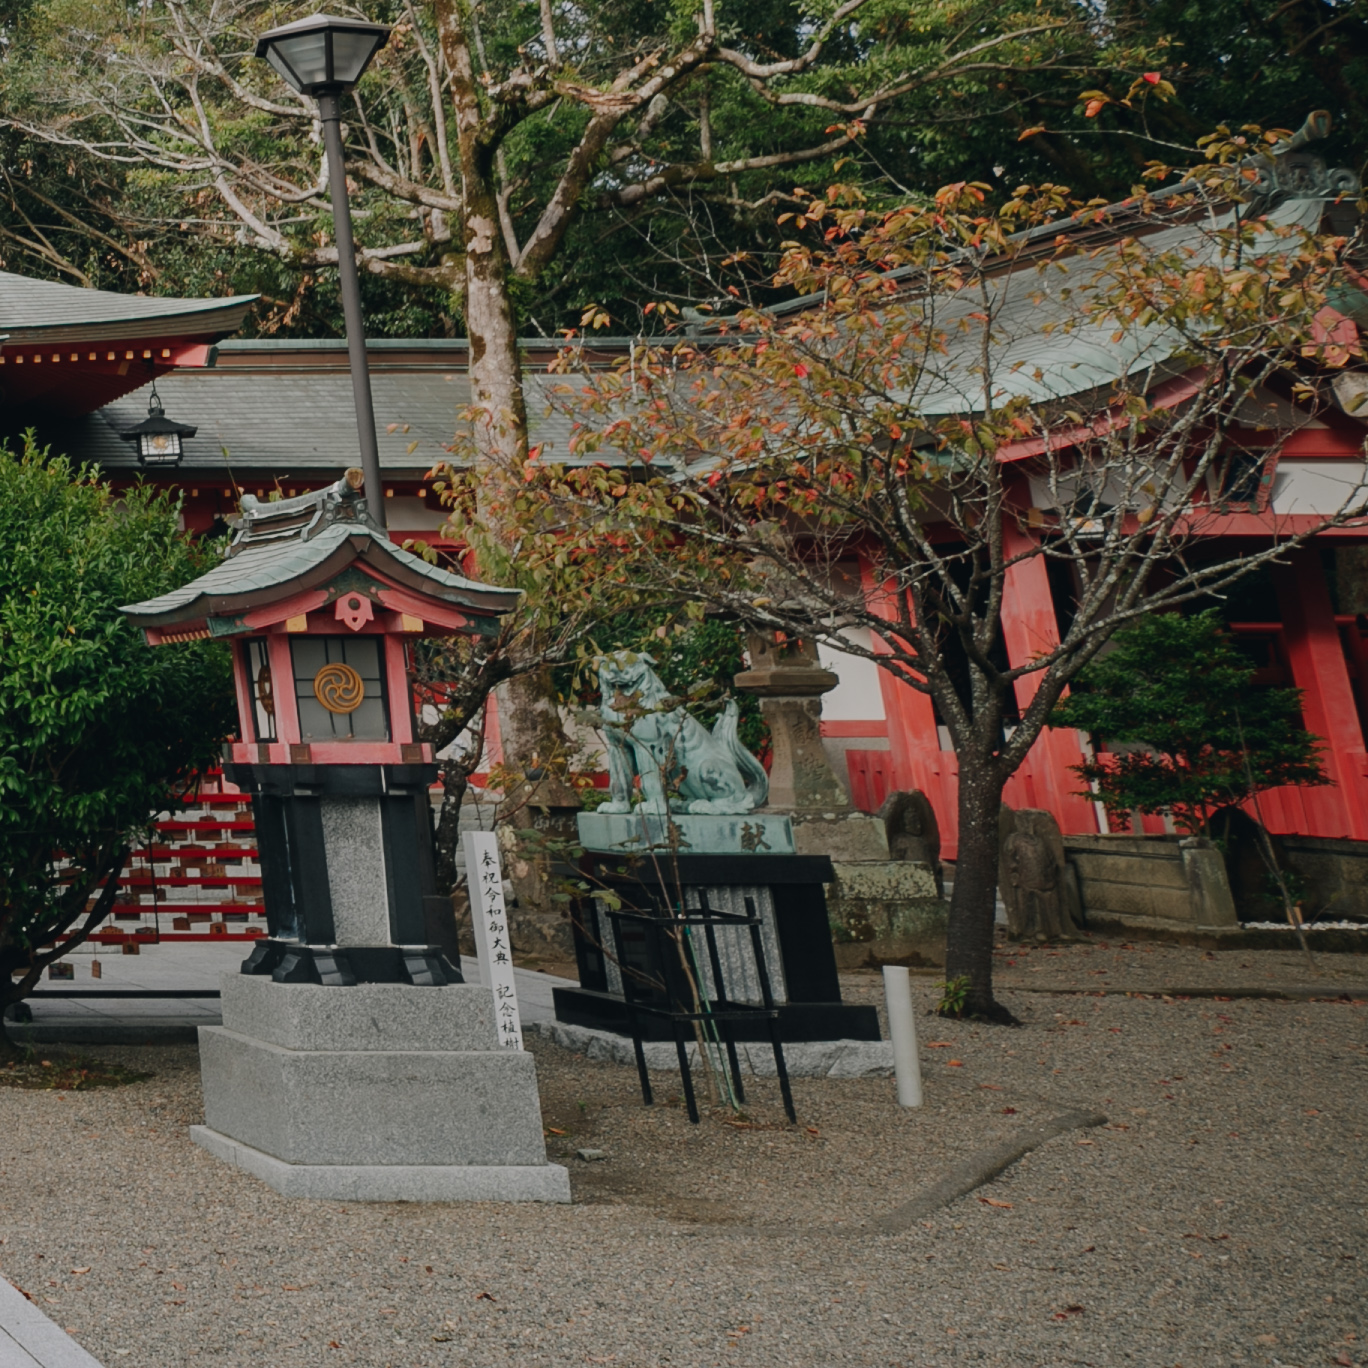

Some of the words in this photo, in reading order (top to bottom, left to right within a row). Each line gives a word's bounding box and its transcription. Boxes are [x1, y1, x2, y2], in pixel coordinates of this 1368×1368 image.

[740, 821, 772, 852] 献
[481, 850, 509, 965] 奉祝令和御大典
